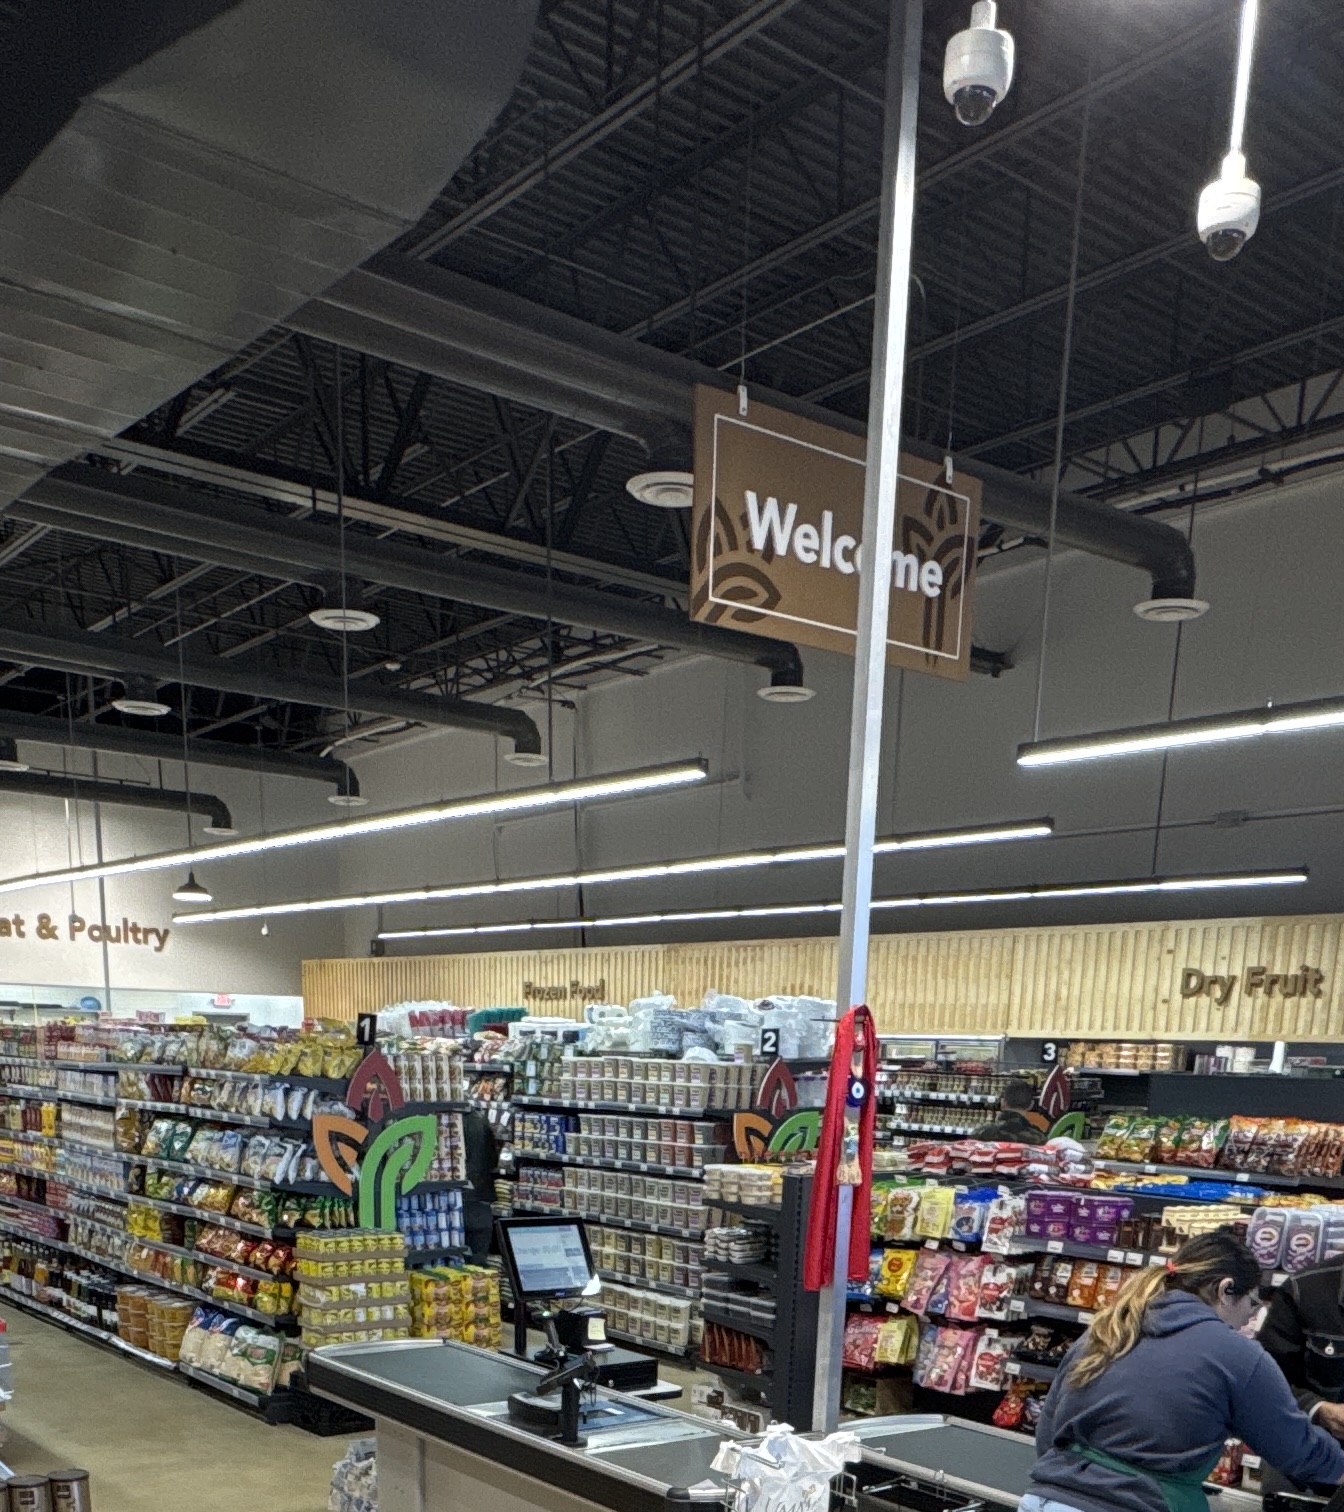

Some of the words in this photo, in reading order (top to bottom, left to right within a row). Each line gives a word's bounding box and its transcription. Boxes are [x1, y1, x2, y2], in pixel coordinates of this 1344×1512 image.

[744, 489, 944, 598] Welcme
[36, 912, 59, 941] &
[68, 913, 170, 953] Poultry
[523, 981, 567, 1001] Frozen
[570, 978, 606, 1001] Food
[1180, 967, 1238, 1007] Dry
[1244, 964, 1325, 999] Fruit
[359, 1017, 371, 1042] 1
[762, 1031, 777, 1053] 2
[1043, 1042, 1057, 1061] 3
